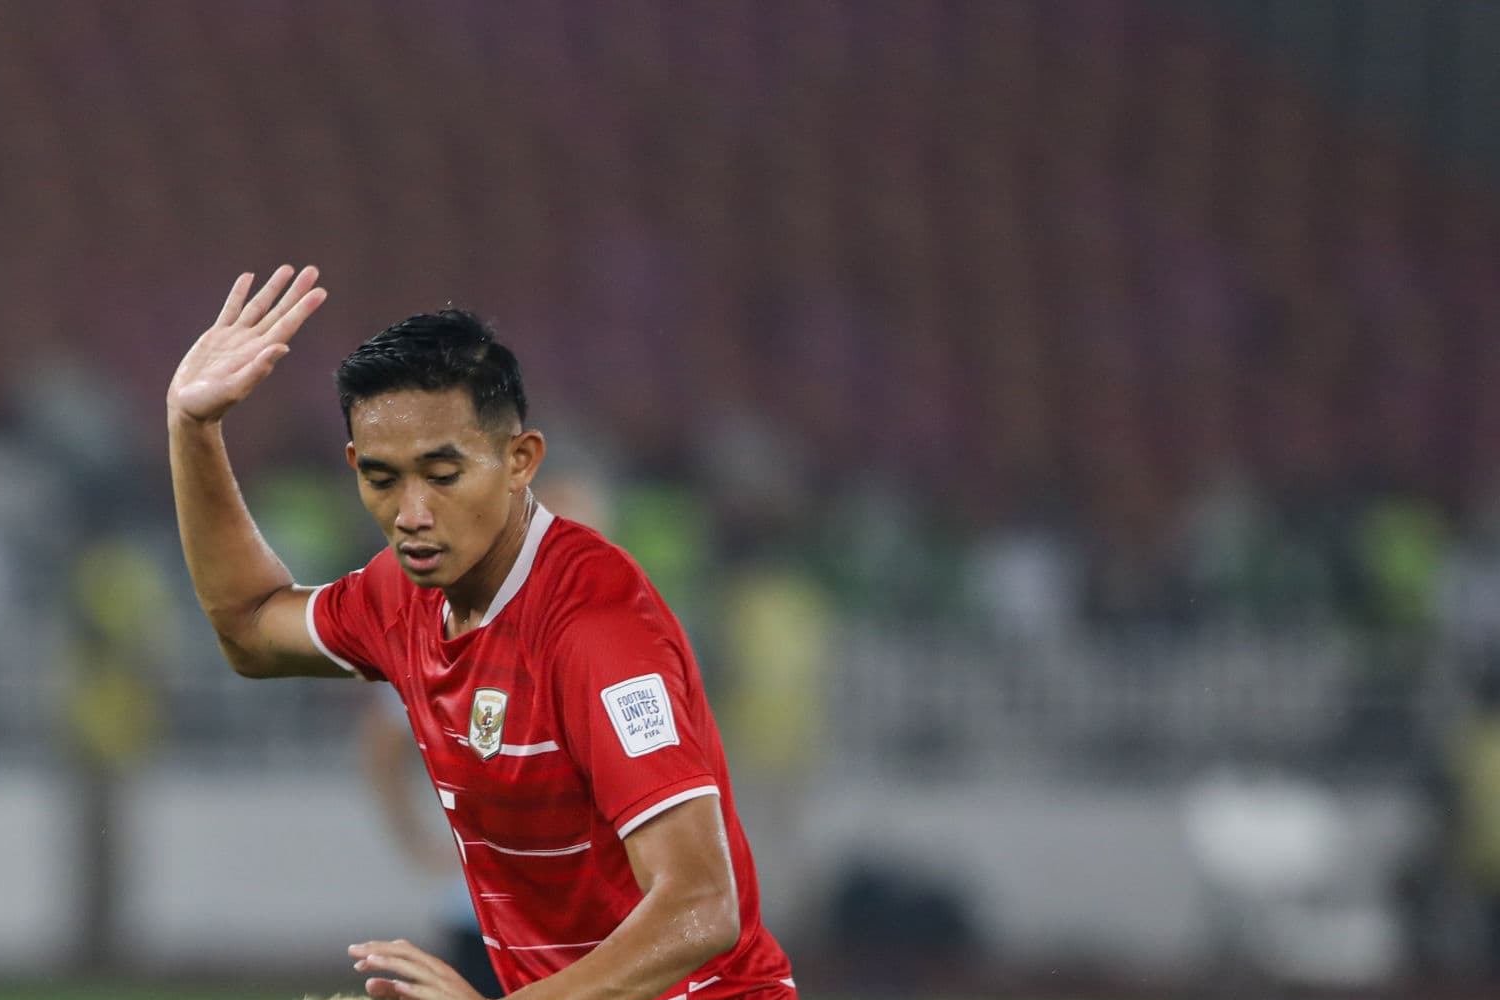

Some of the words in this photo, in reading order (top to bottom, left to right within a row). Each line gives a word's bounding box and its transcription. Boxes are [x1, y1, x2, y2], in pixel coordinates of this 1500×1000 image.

[617, 688, 655, 707] FOOTBALL
[621, 699, 660, 722] UNITES
[626, 723, 643, 736] the
